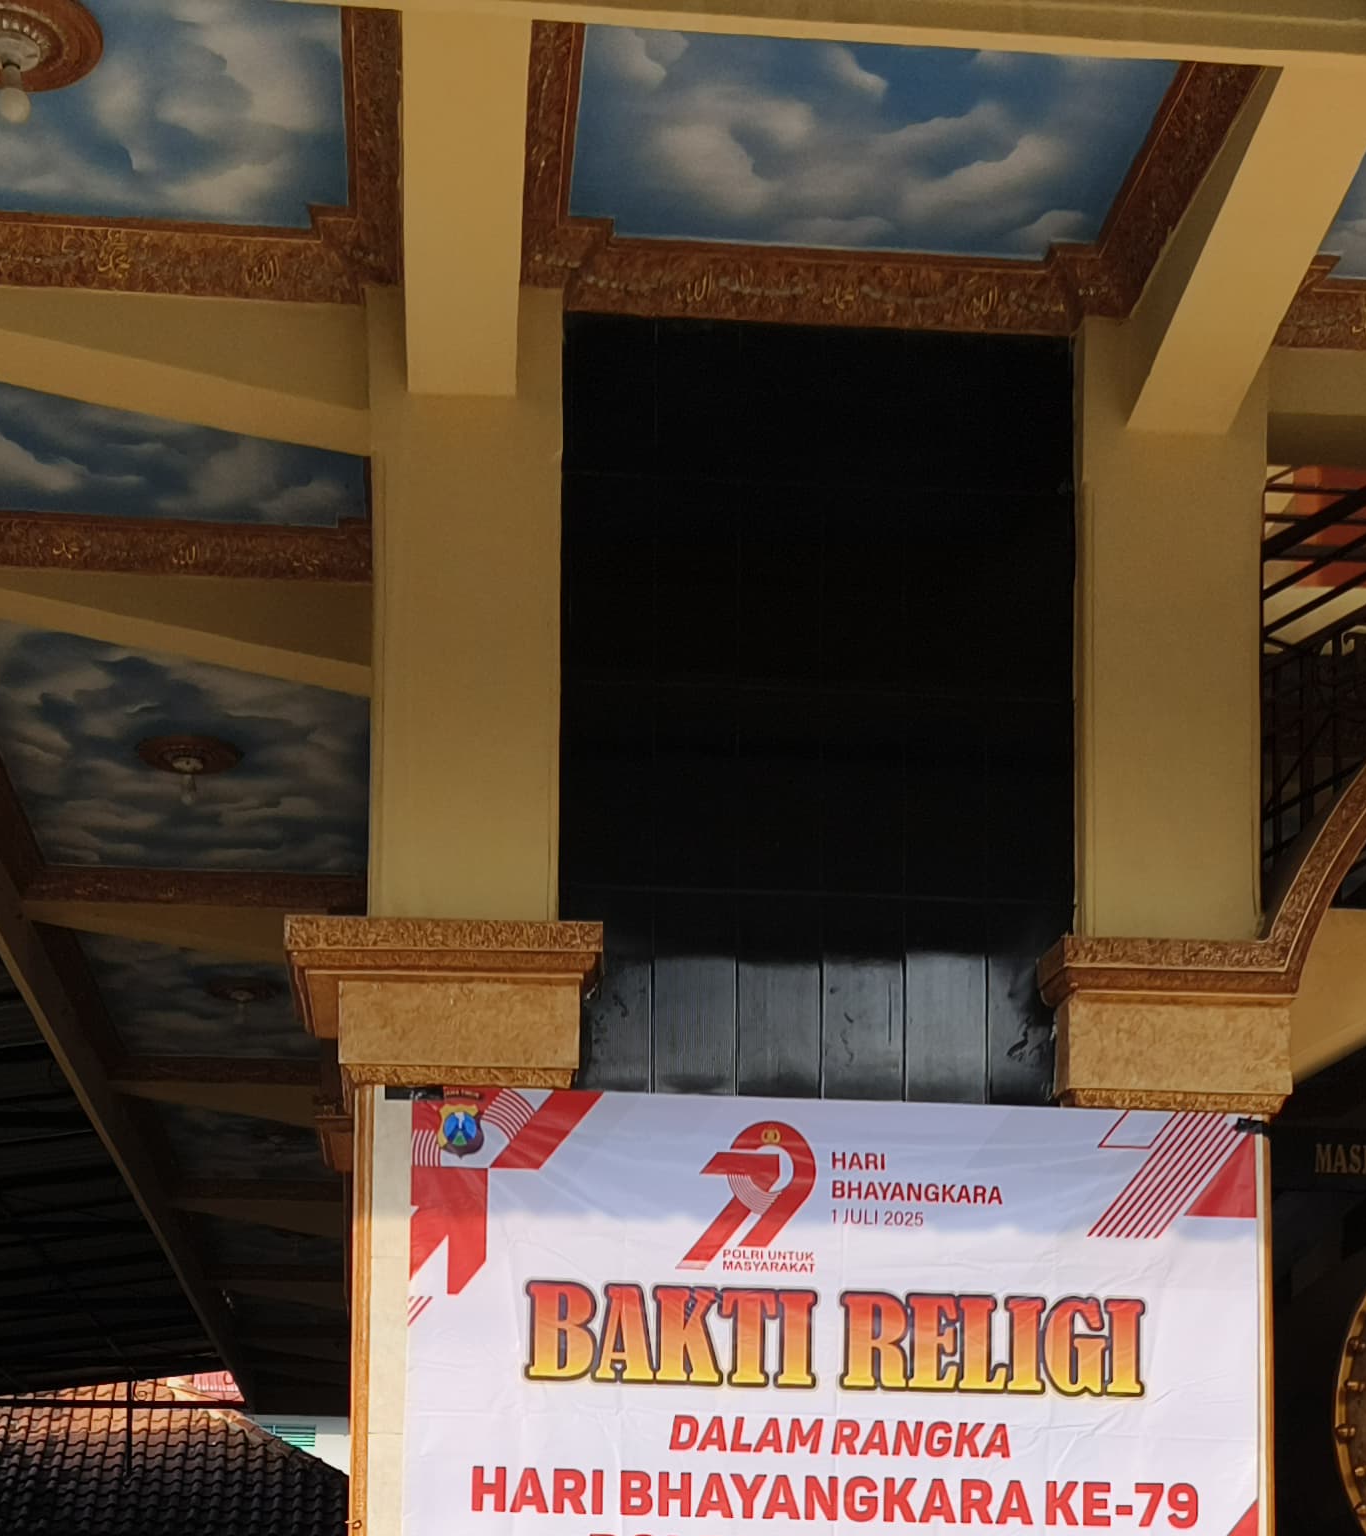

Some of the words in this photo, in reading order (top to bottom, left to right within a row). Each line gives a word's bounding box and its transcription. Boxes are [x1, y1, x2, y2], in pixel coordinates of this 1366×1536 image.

[831, 1152, 886, 1171] HARI
[831, 1181, 1003, 1205] BHAYANGKARA
[831, 1210, 838, 1224] 1
[843, 1210, 879, 1225] JULI
[884, 1211, 924, 1227] 2025
[723, 1249, 765, 1260] POLRI
[768, 1250, 815, 1262] UNTUK
[722, 1260, 816, 1274] MASYARAKAT
[523, 1279, 819, 1390] BAKTI
[839, 1290, 1147, 1398] RELIGI
[669, 1414, 823, 1456] DALAM
[831, 1420, 1012, 1460] RANGKA
[470, 1466, 605, 1517] HARI
[620, 1469, 1036, 1527] BHAYANGKARA
[1044, 1480, 1200, 1531] KE-79
